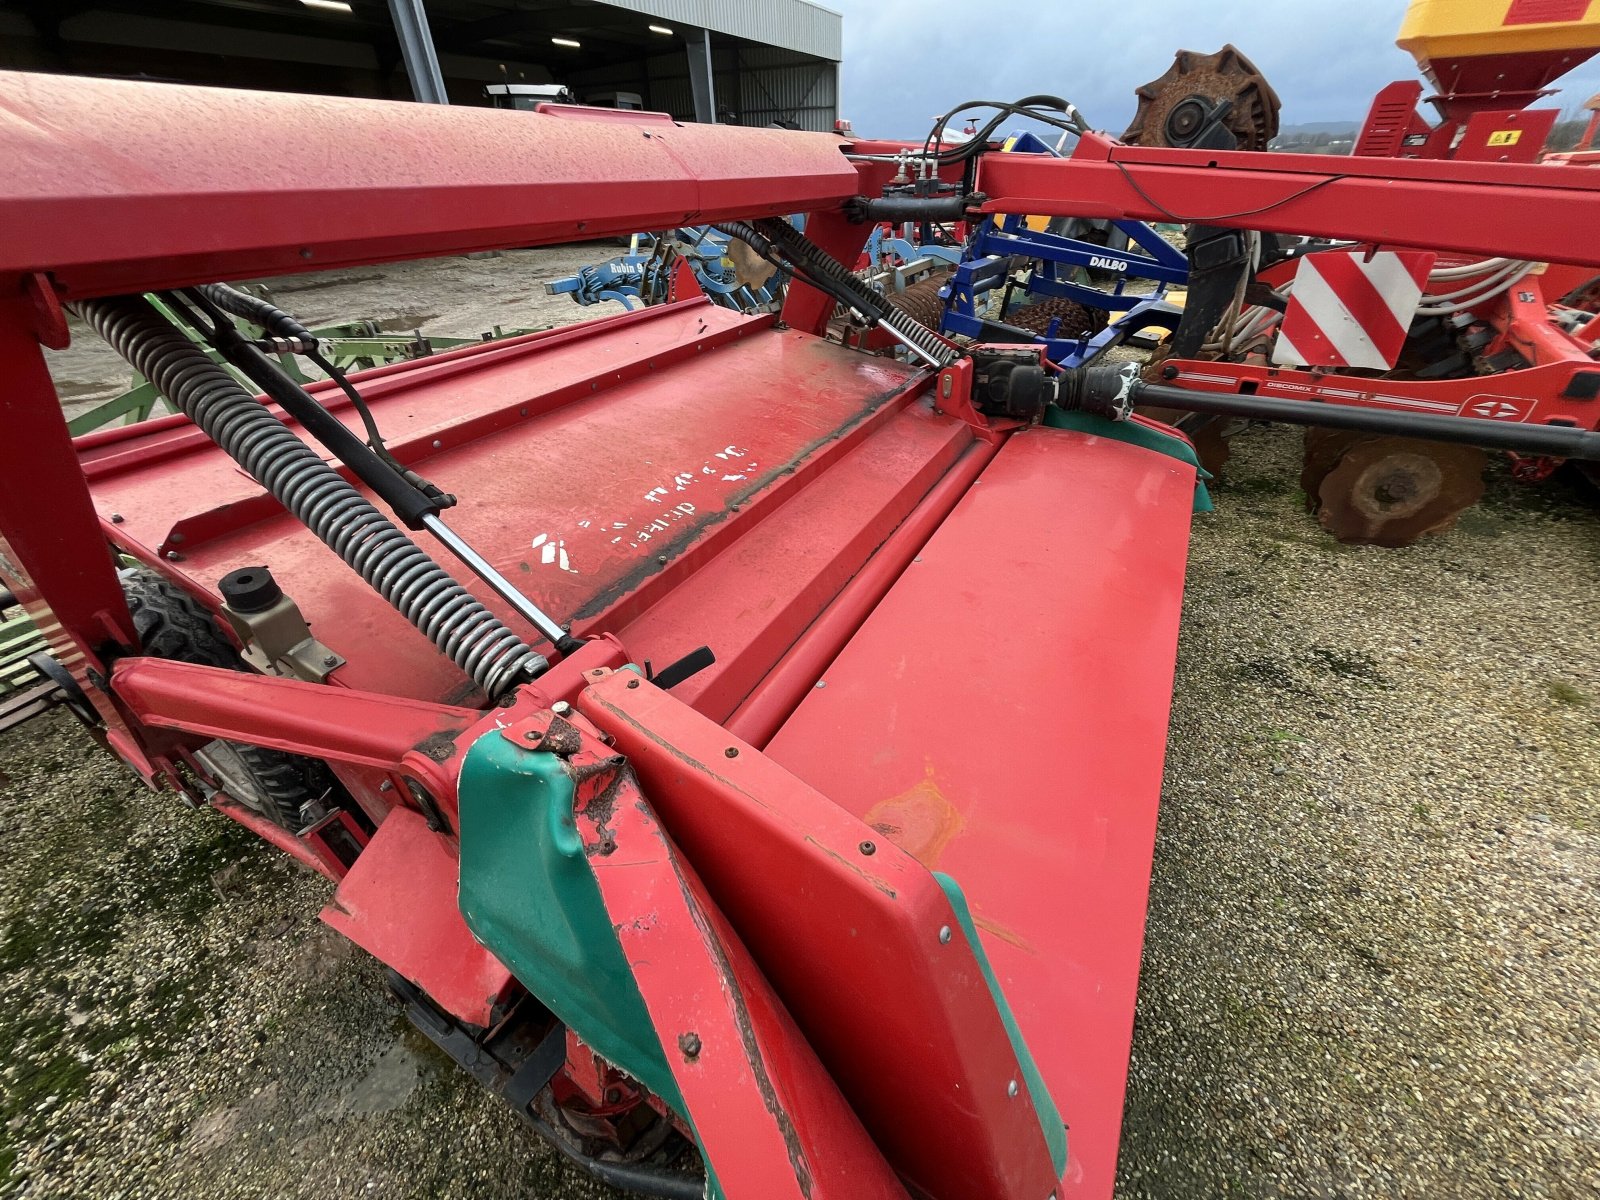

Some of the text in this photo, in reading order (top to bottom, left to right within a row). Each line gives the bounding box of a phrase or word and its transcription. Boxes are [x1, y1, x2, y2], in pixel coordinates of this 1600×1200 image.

[610, 263, 635, 273] Rubin
[1090, 256, 1128, 271] DALBO
[1266, 381, 1312, 392] DISCOMIX
